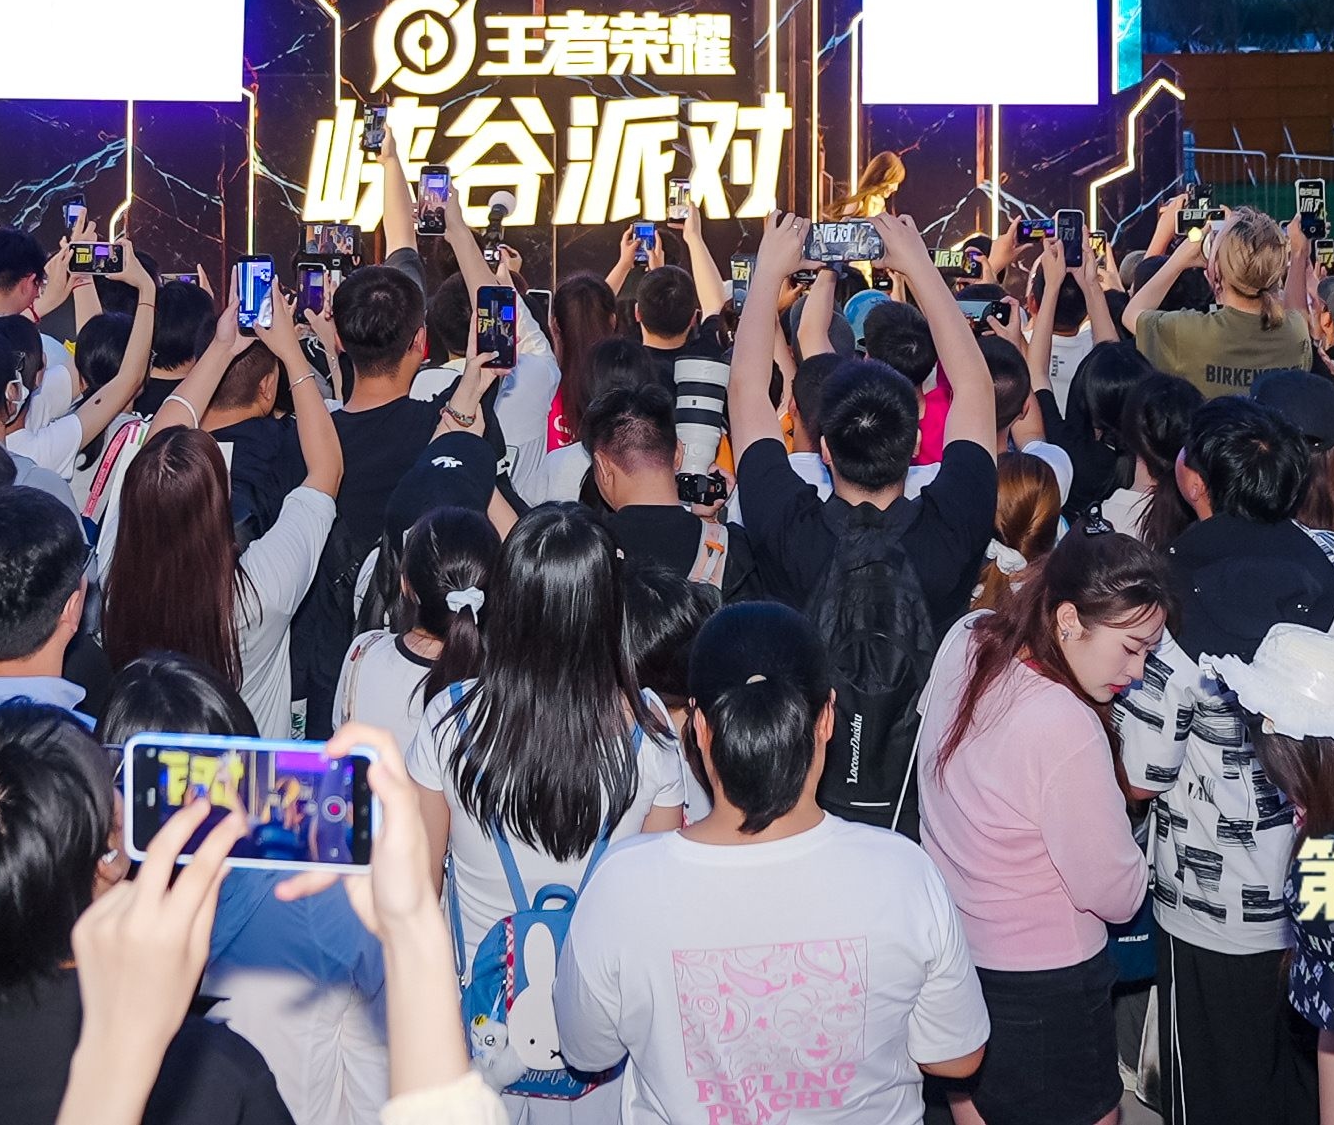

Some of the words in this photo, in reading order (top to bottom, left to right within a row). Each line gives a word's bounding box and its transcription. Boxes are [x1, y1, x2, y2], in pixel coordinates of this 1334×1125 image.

[477, 10, 736, 76] 王者荣耀
[302, 92, 793, 232] 峡谷派对
[695, 1062, 857, 1105] FEELING
[706, 1085, 850, 1125] PEACHY
